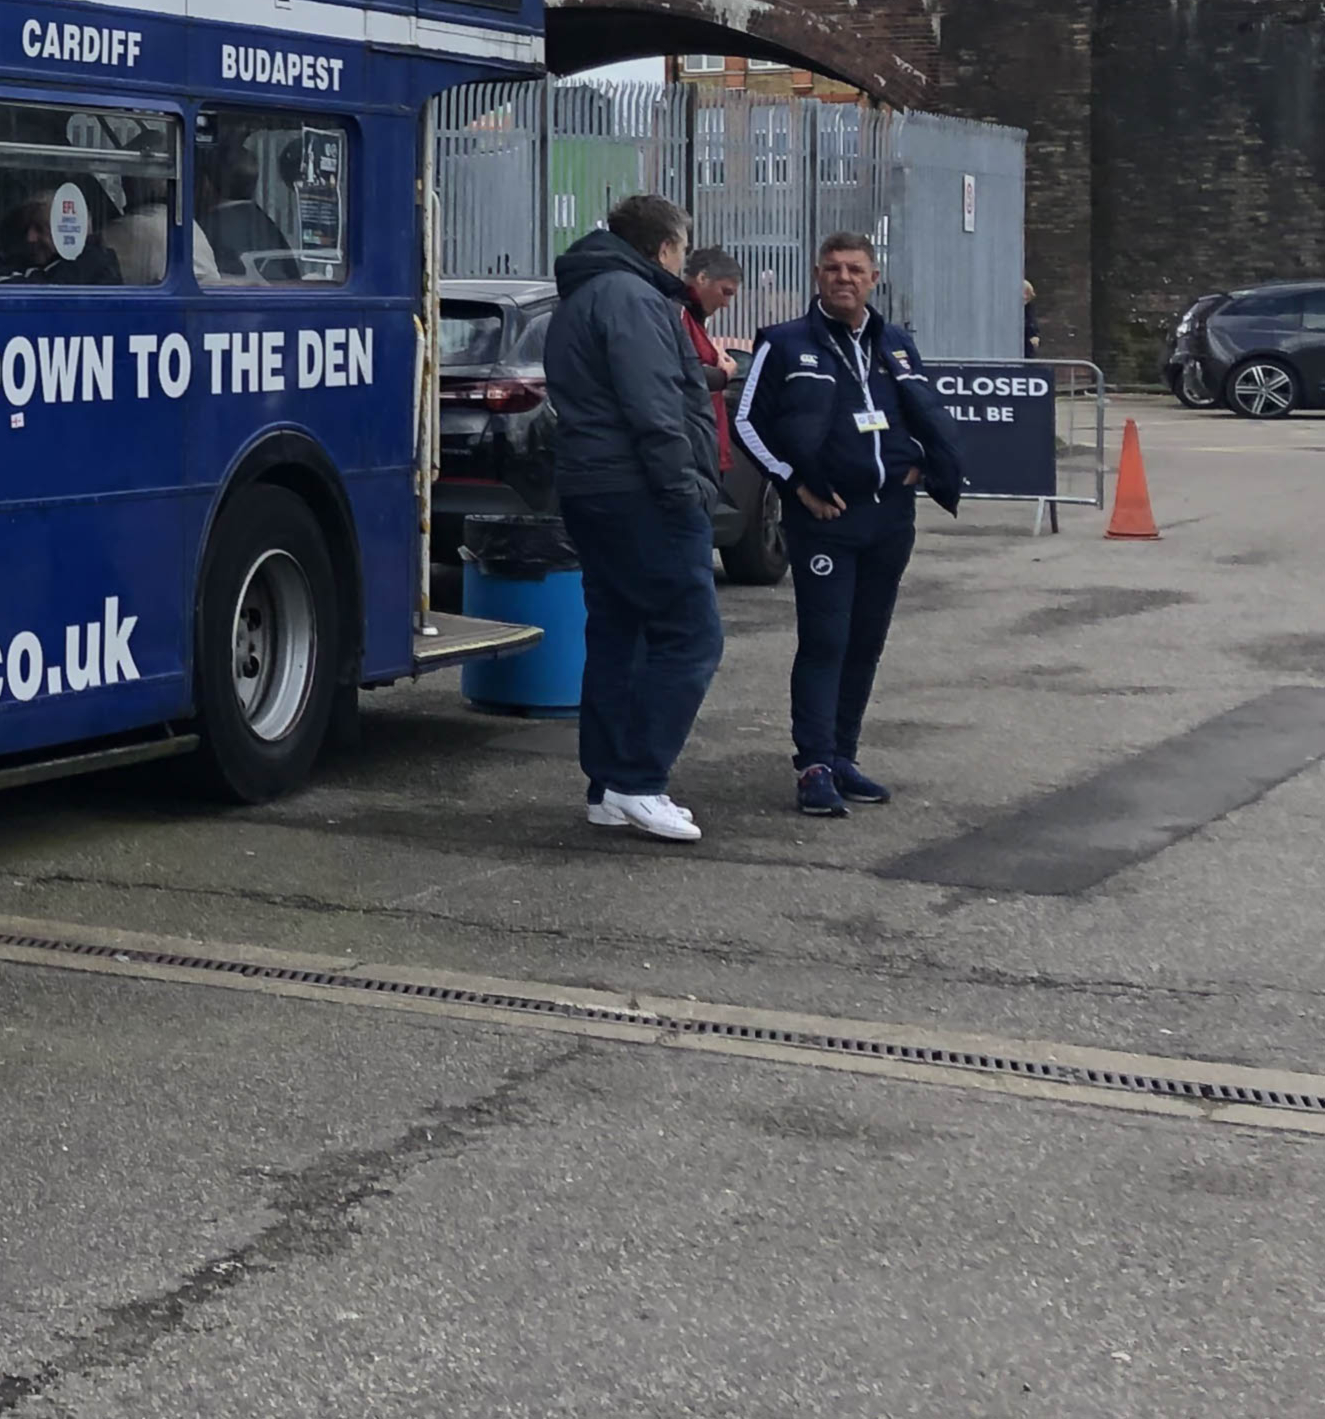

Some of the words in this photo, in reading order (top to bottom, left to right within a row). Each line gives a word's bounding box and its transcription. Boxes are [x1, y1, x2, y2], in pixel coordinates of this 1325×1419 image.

[22, 20, 142, 66] CARDIFF
[222, 45, 343, 90] BUDAPEST
[129, 333, 191, 398] TO
[203, 331, 285, 395] THE
[297, 328, 373, 389] DEN
[936, 376, 1048, 396] CLOSED
[944, 406, 981, 421] ILL
[987, 407, 1014, 422] BE
